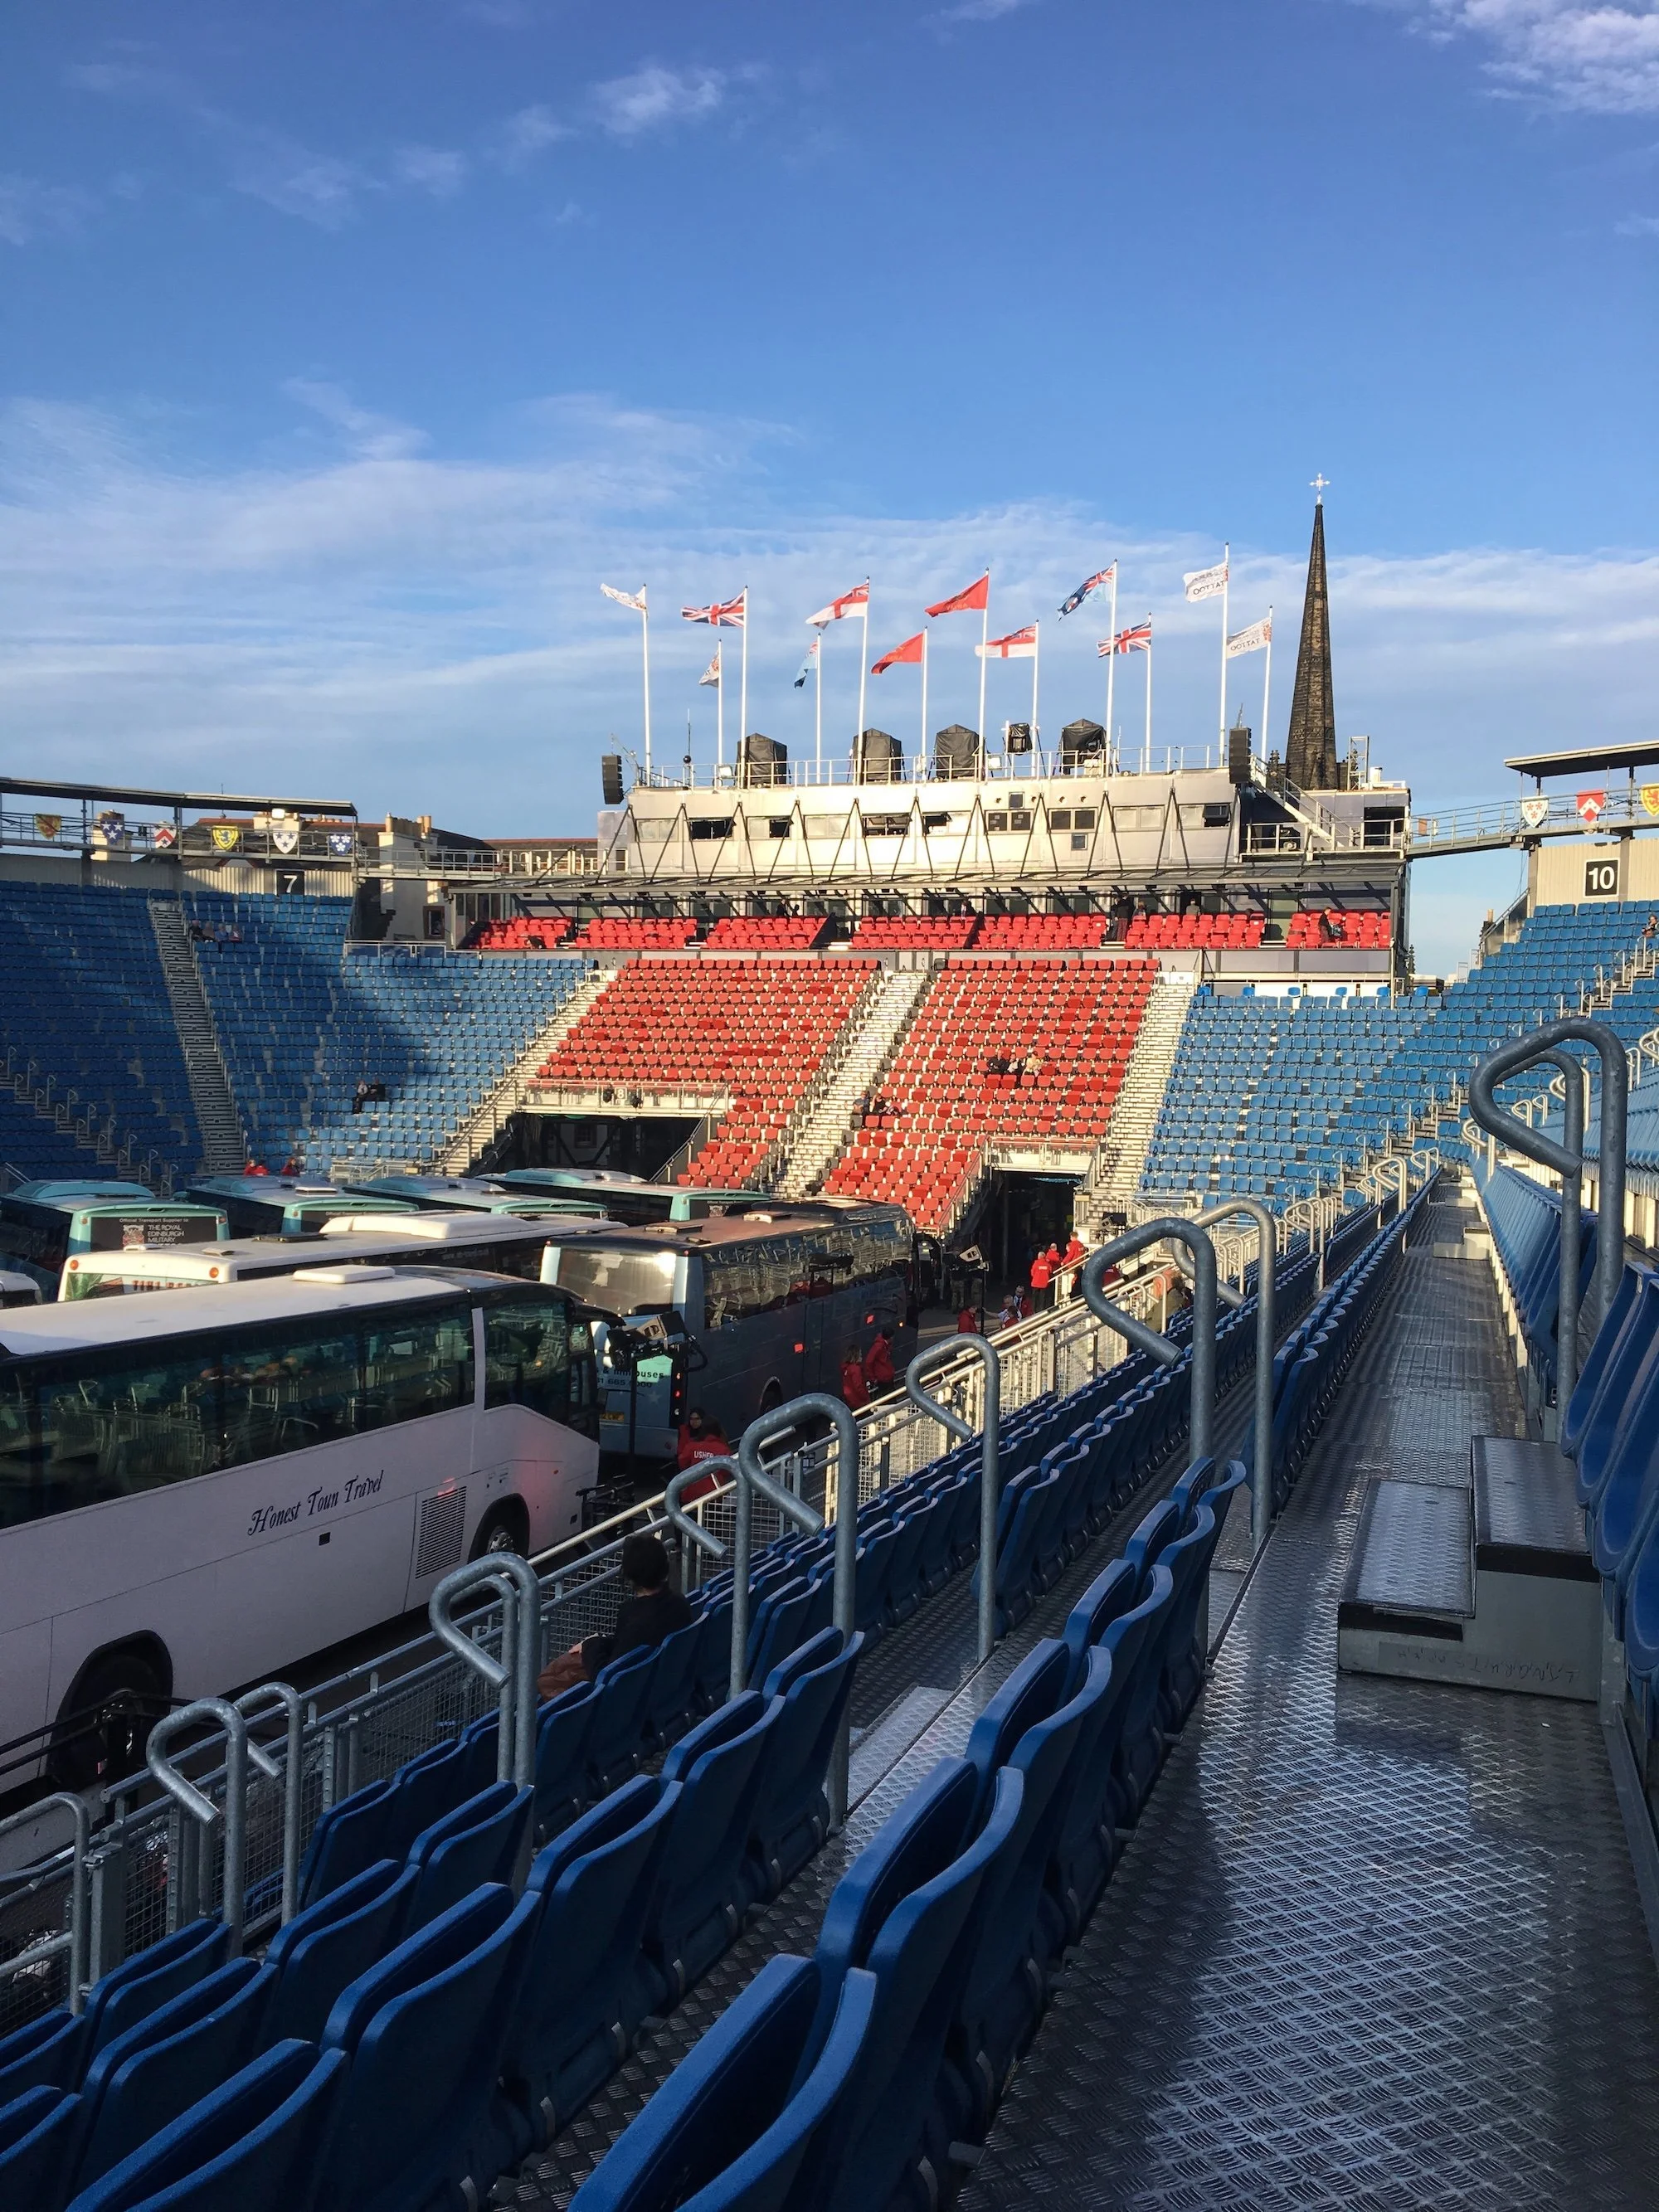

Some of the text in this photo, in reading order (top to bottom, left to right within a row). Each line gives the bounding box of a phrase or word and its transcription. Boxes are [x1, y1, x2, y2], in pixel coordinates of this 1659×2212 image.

[284, 874, 298, 893] 7
[1588, 866, 1615, 890] 10
[617, 1088, 625, 1099] 8
[247, 1469, 384, 1536] Honest Toun Travel
